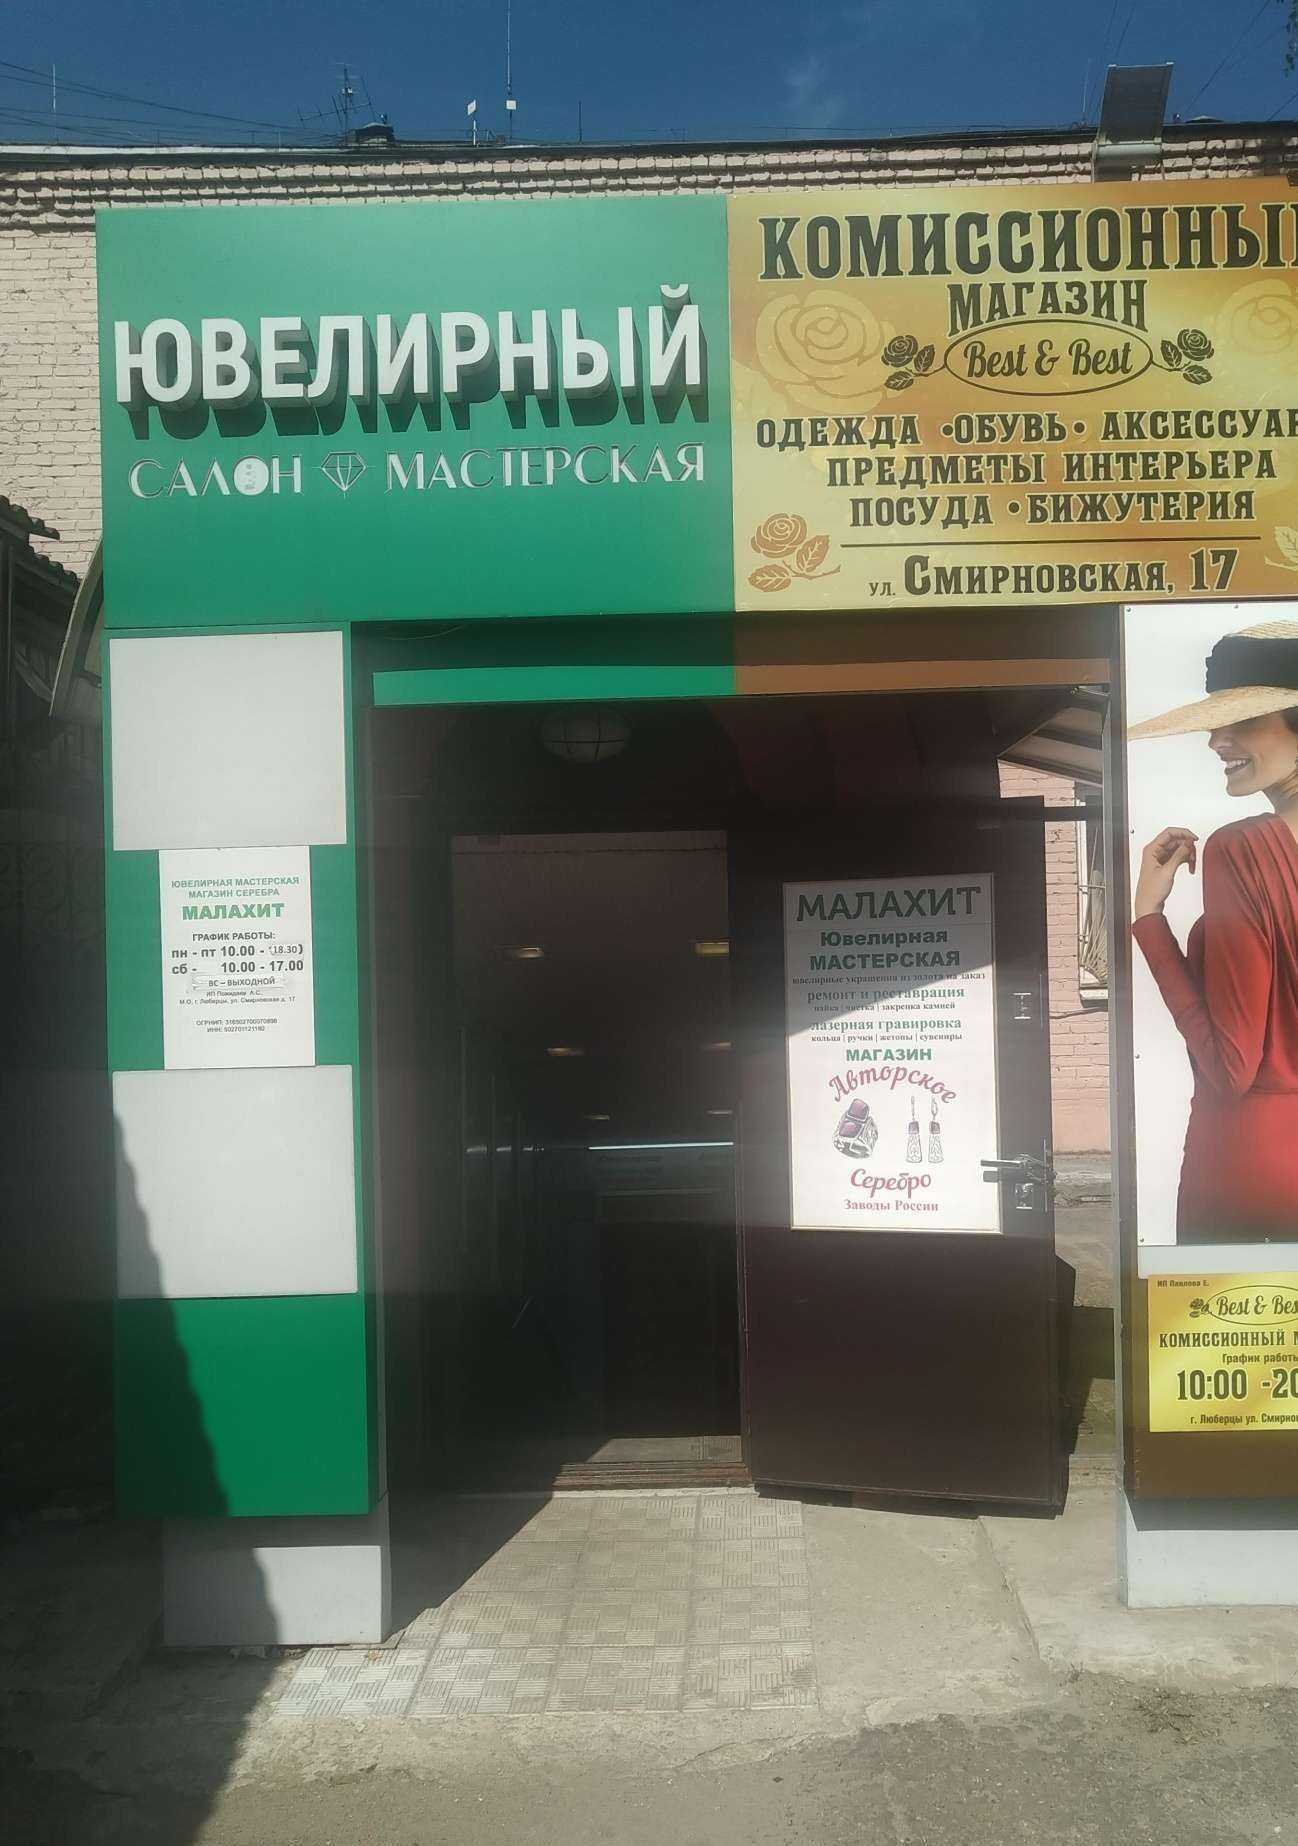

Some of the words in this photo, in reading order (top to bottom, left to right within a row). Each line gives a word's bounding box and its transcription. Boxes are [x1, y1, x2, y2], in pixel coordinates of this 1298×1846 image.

[758, 204, 1298, 279] КОМИССИОННЫ
[947, 280, 1148, 336] МАГАЗИН
[113, 284, 702, 403] ЮВЕЛИРНЫЙ
[963, 341, 1028, 377] Best
[1034, 339, 1060, 376] &
[1068, 338, 1133, 375] Best
[756, 415, 920, 451] ОДЕЖДА
[128, 455, 304, 498] САЛОН
[385, 443, 705, 492] МАСТЕРСКАЯ
[827, 453, 1045, 488] ПРЕДМЕТЫ
[1064, 449, 1278, 482] ИНТЕРЬЕРА
[849, 494, 994, 529] ПОСУДА
[1028, 490, 1256, 524] БИЖУТЕРИЯ
[1189, 548, 1238, 592] 17
[172, 880, 232, 888] ЮВЕЛИРНАЯ
[235, 877, 300, 886] МАСТЕРСКАЯ
[189, 890, 233, 898] МАГАЗИН
[235, 888, 280, 897] СЕРЕБРА
[182, 903, 285, 920] МАЛАХИТ
[797, 887, 981, 922] МАЛАХИТ
[193, 933, 230, 941] ГРАФИК
[232, 932, 276, 940] РАБОТЫ:
[820, 930, 948, 948] Ювелирная
[221, 945, 255, 957] 10.00
[221, 962, 255, 973] 10.00
[269, 960, 303, 971] 17.00
[810, 951, 961, 971] МАСТЕРСКАЯ
[227, 977, 275, 986] ВЫХОДНОЙ
[807, 991, 855, 1004] ремонт
[873, 988, 965, 1002] реставрация
[811, 1021, 874, 1033] лазерная
[878, 1019, 962, 1033] гравировка
[847, 1035, 873, 1043] ручки
[919, 1034, 962, 1042] сувениры
[846, 1048, 932, 1062] МАГАЗИН
[828, 1065, 957, 1104] Авторское
[850, 1168, 931, 1199] Серебро
[843, 1199, 891, 1212] Заводы
[895, 1199, 939, 1212] России
[1216, 1296, 1250, 1315] Best
[1254, 1295, 1267, 1315] &
[1159, 1329, 1285, 1348] КОМИССИОННЫЙ
[1222, 1353, 1260, 1365] График
[1177, 1369, 1247, 1400] 10:00
[1200, 1414, 1242, 1425] Люберцы
[1262, 1412, 1298, 1424] Смирно
